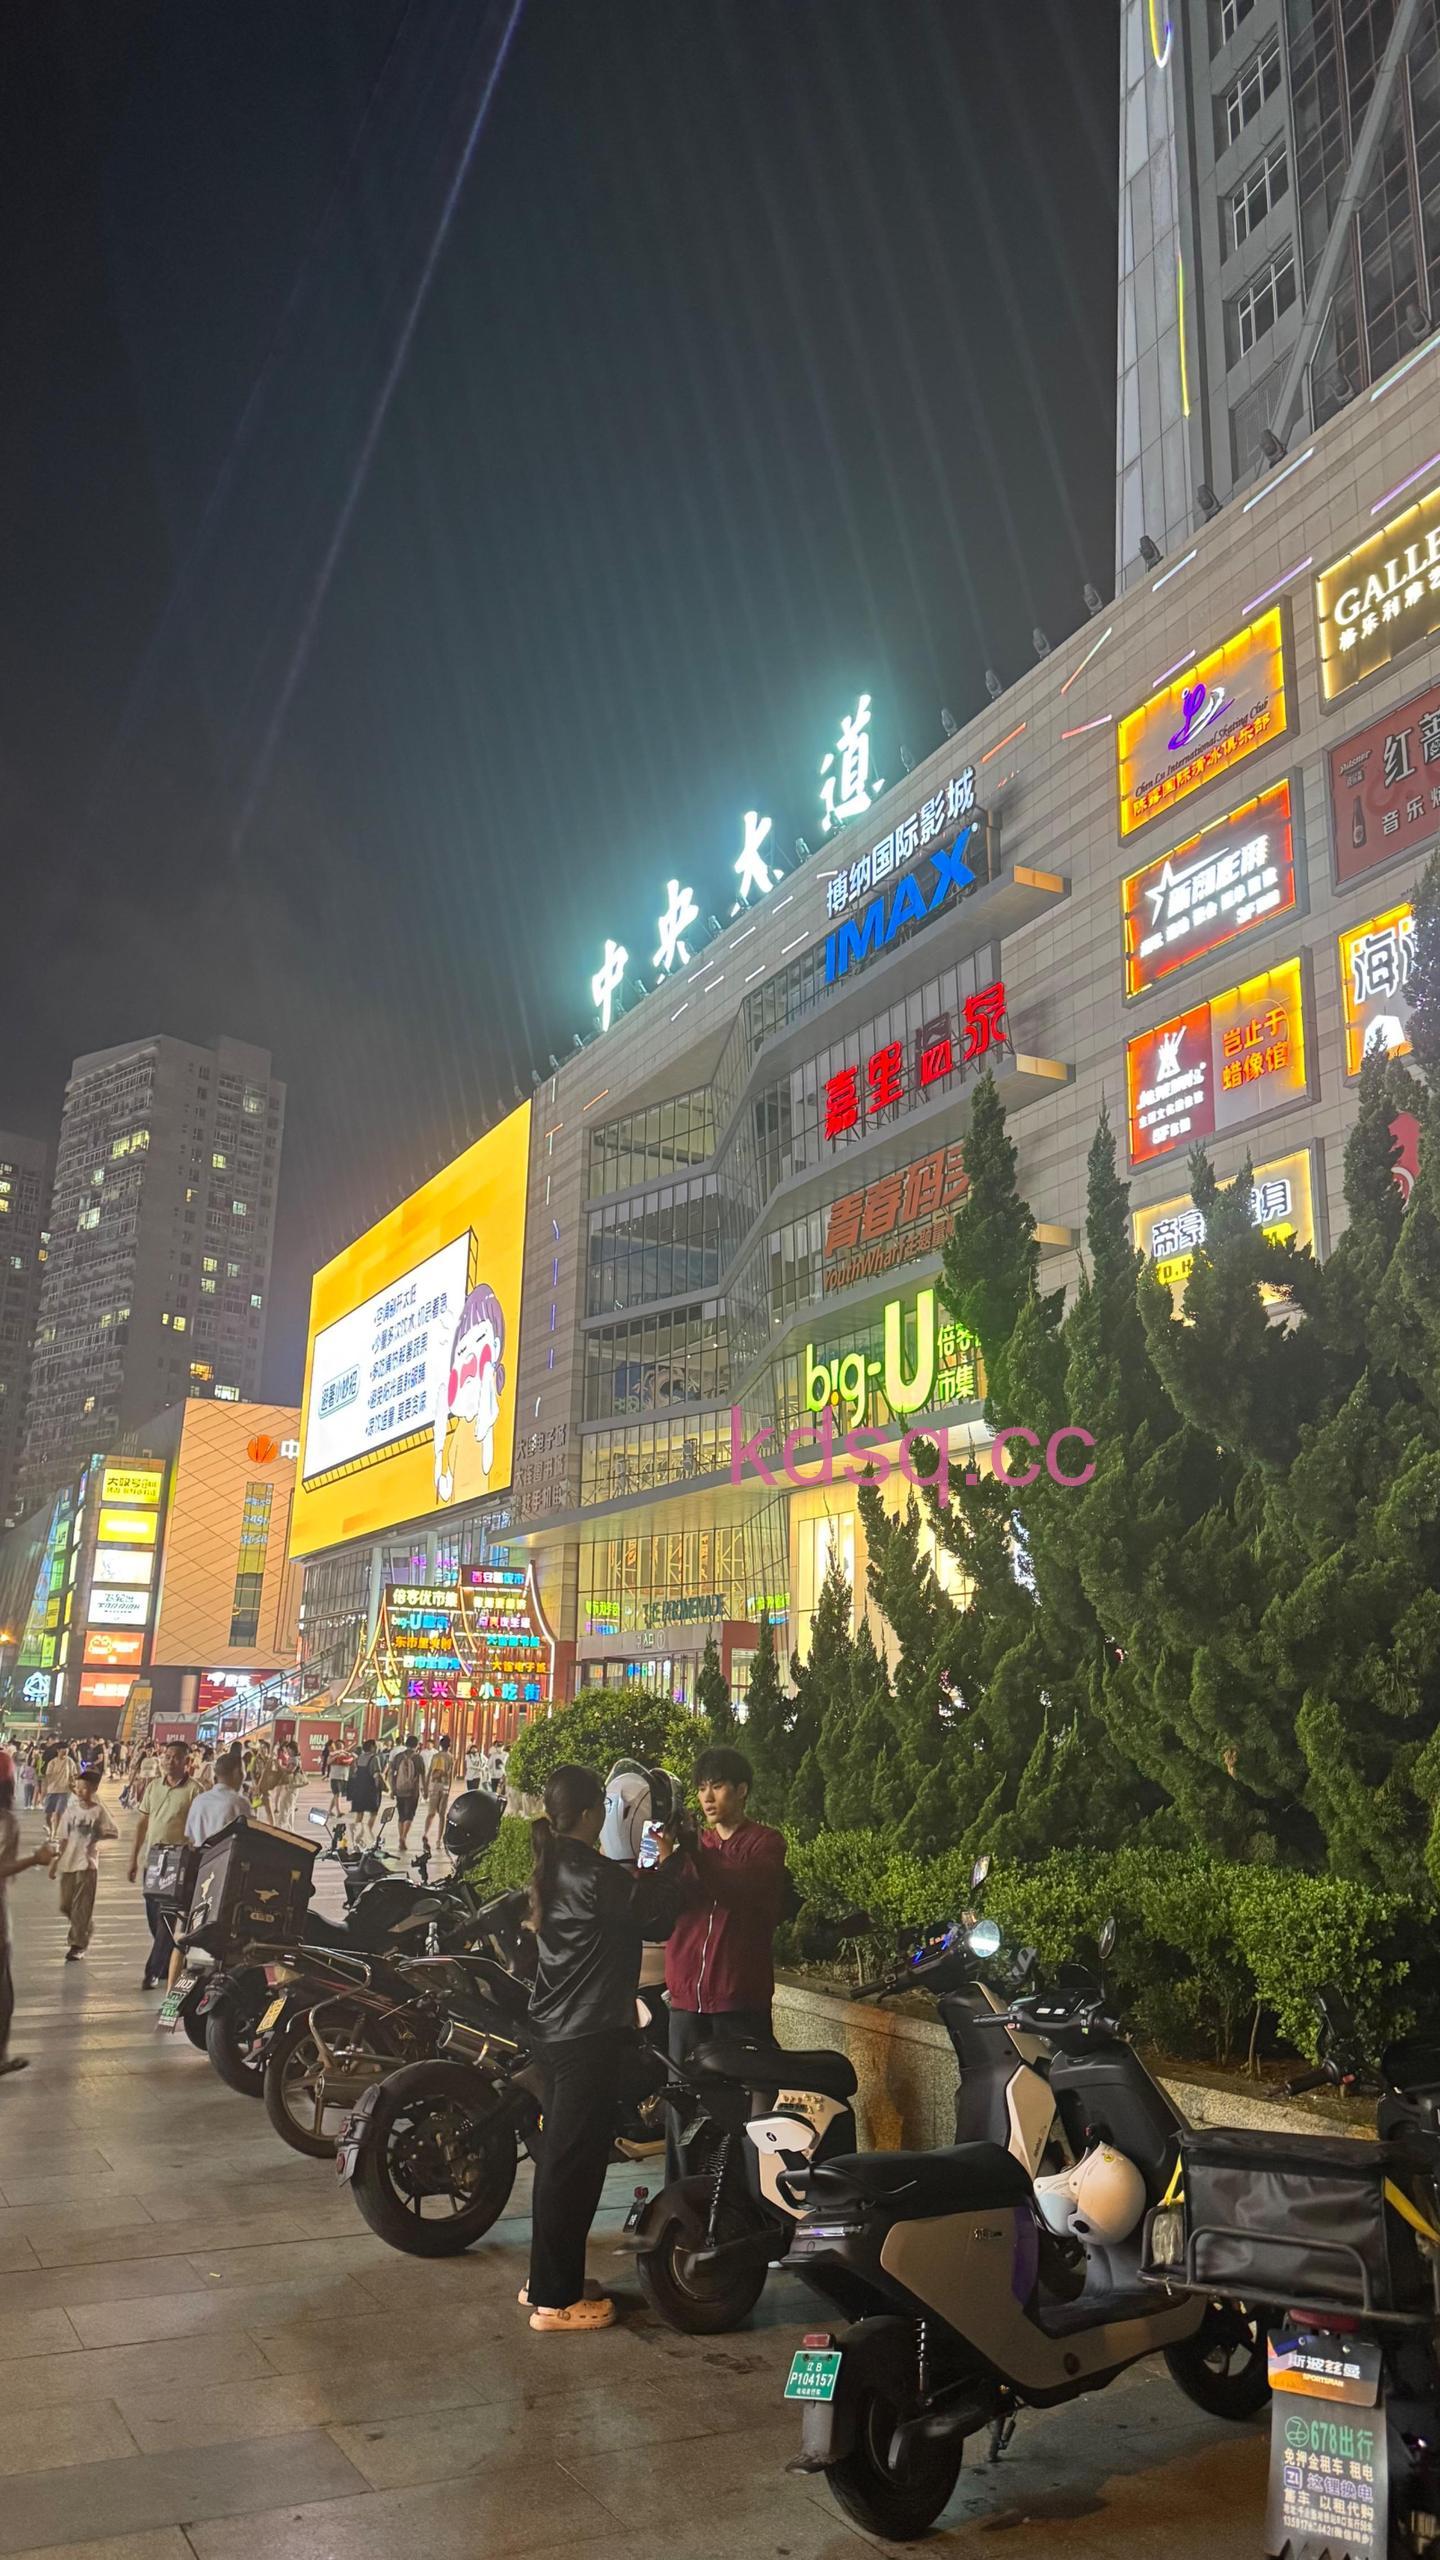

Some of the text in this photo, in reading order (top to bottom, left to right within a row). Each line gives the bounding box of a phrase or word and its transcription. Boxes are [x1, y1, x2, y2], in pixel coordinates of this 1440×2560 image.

[1167, 732, 1217, 775] International
[1218, 713, 1249, 742] Skating
[592, 694, 885, 1032] 中央大道
[827, 764, 976, 919] 博纳国际影城
[824, 825, 976, 985] IMAX
[1223, 1007, 1286, 1058] 岂止于
[1222, 1040, 1288, 1092] 蜡像馆
[806, 1288, 935, 1428] big-U
[937, 1364, 974, 1403] 市集
[789, 2371, 834, 2388] P104157
[1284, 2447, 1374, 2482] 免押金租车 租电
[1310, 2420, 1374, 2460] 678出行
[1319, 2496, 1374, 2521] 以租代购
